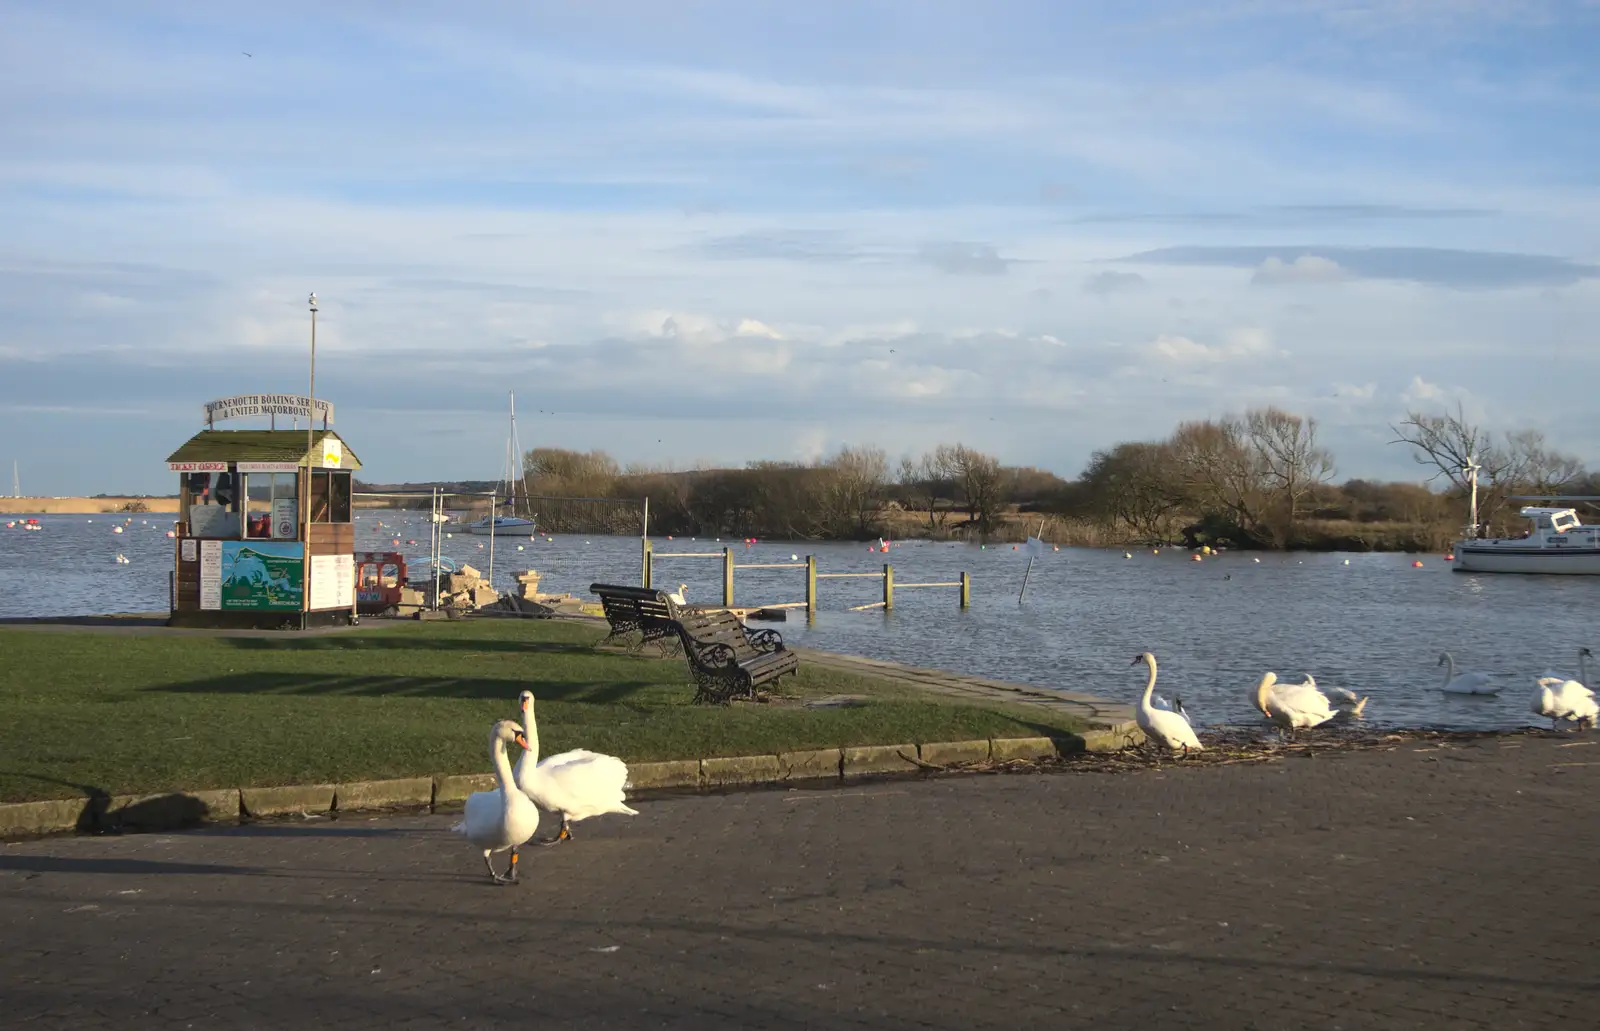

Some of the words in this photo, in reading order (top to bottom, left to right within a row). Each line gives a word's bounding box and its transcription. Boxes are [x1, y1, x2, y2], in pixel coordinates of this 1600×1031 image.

[206, 395, 259, 412] BOURNEMOUTH
[261, 395, 294, 406] BOATING
[296, 396, 329, 411] SERICES
[223, 409, 229, 418] &
[231, 406, 259, 417] UNITED
[261, 405, 311, 417] MOTORBOATS
